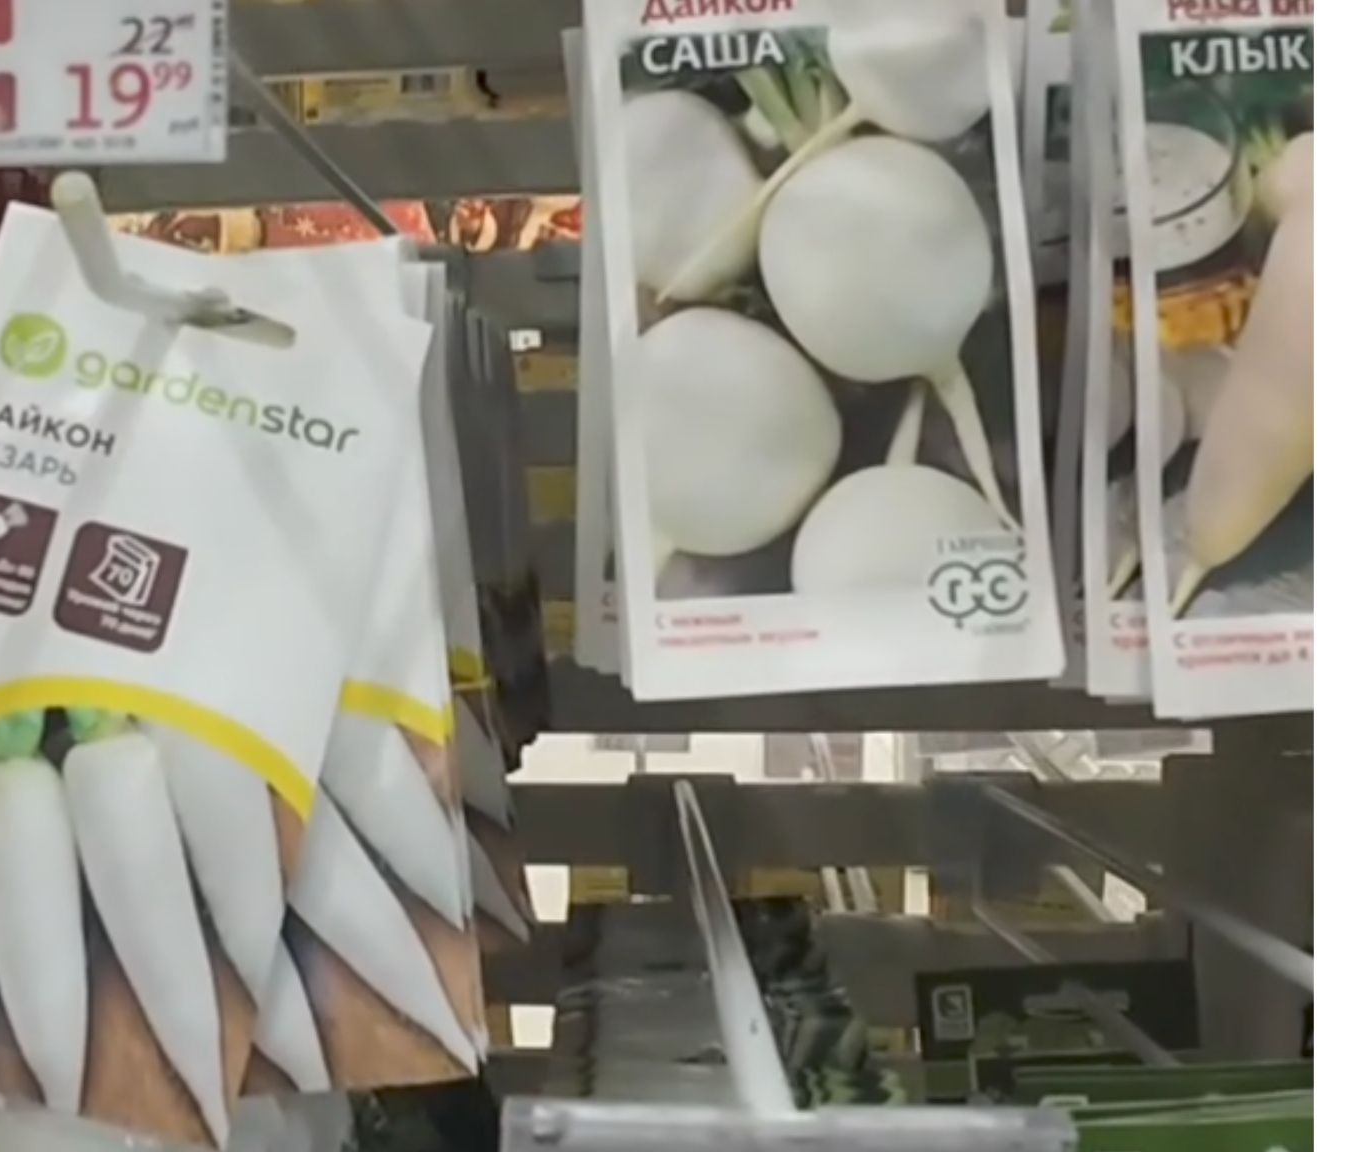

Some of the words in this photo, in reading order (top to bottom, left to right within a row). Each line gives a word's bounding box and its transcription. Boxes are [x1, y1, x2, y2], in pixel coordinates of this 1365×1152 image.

[642, 29, 785, 75] САША
[1171, 35, 1311, 77] КЛЫК
[75, 350, 359, 454] gardenstar
[107, 563, 134, 587] 70
